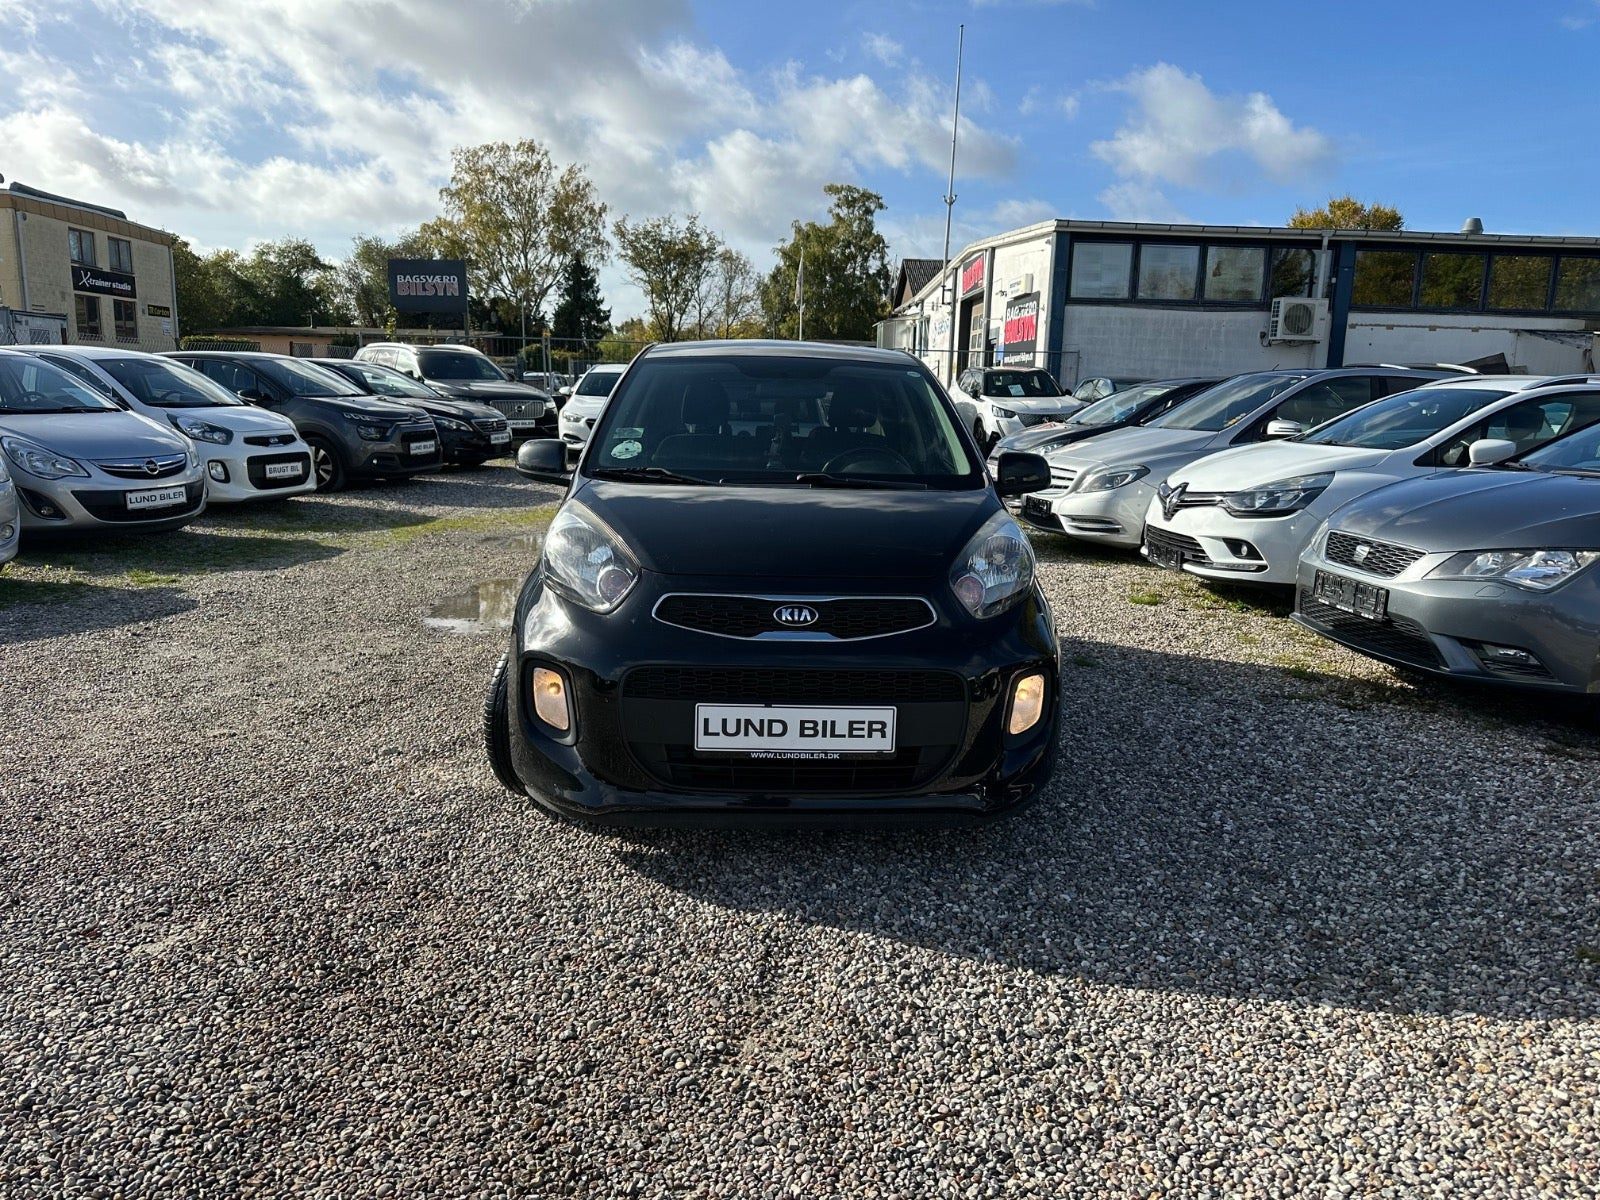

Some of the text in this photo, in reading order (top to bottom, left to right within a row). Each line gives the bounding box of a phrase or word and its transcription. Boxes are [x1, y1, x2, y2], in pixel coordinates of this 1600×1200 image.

[79, 270, 132, 291] X-trainer studio
[396, 274, 458, 283] BAGSVÆRD
[396, 281, 460, 297] BILSYN
[268, 466, 288, 474] BRUGT
[129, 491, 185, 504] LUND BILER
[781, 608, 812, 622] KIA
[703, 718, 887, 739] LUND BILER
